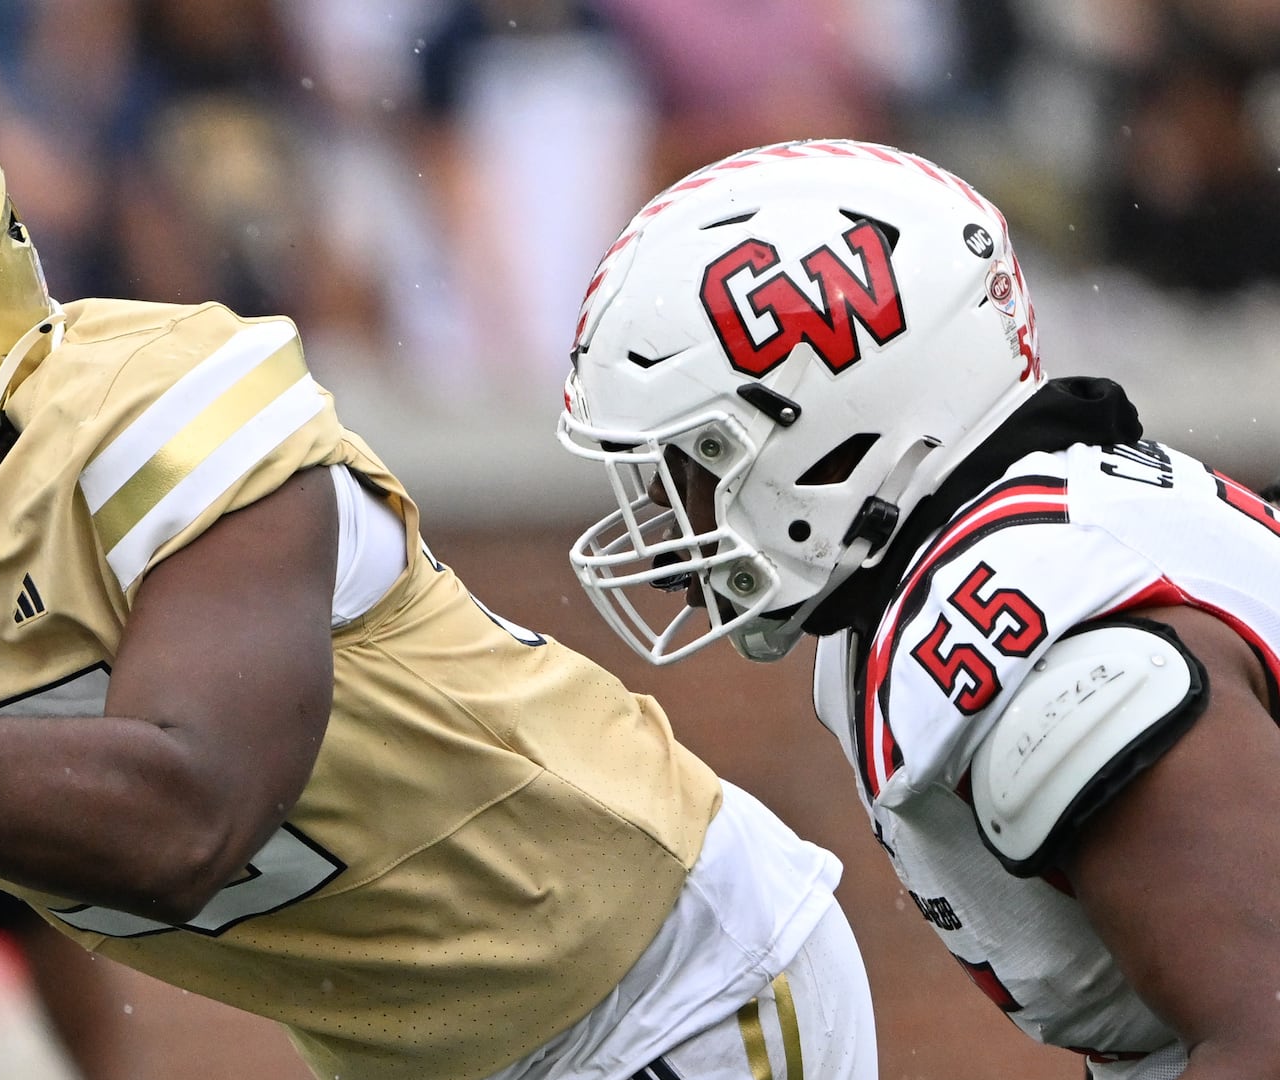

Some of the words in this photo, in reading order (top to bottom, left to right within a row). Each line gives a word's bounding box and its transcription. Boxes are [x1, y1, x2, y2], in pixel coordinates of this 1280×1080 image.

[699, 219, 907, 379] GW
[966, 229, 992, 254] WC
[909, 560, 1049, 717] 55
